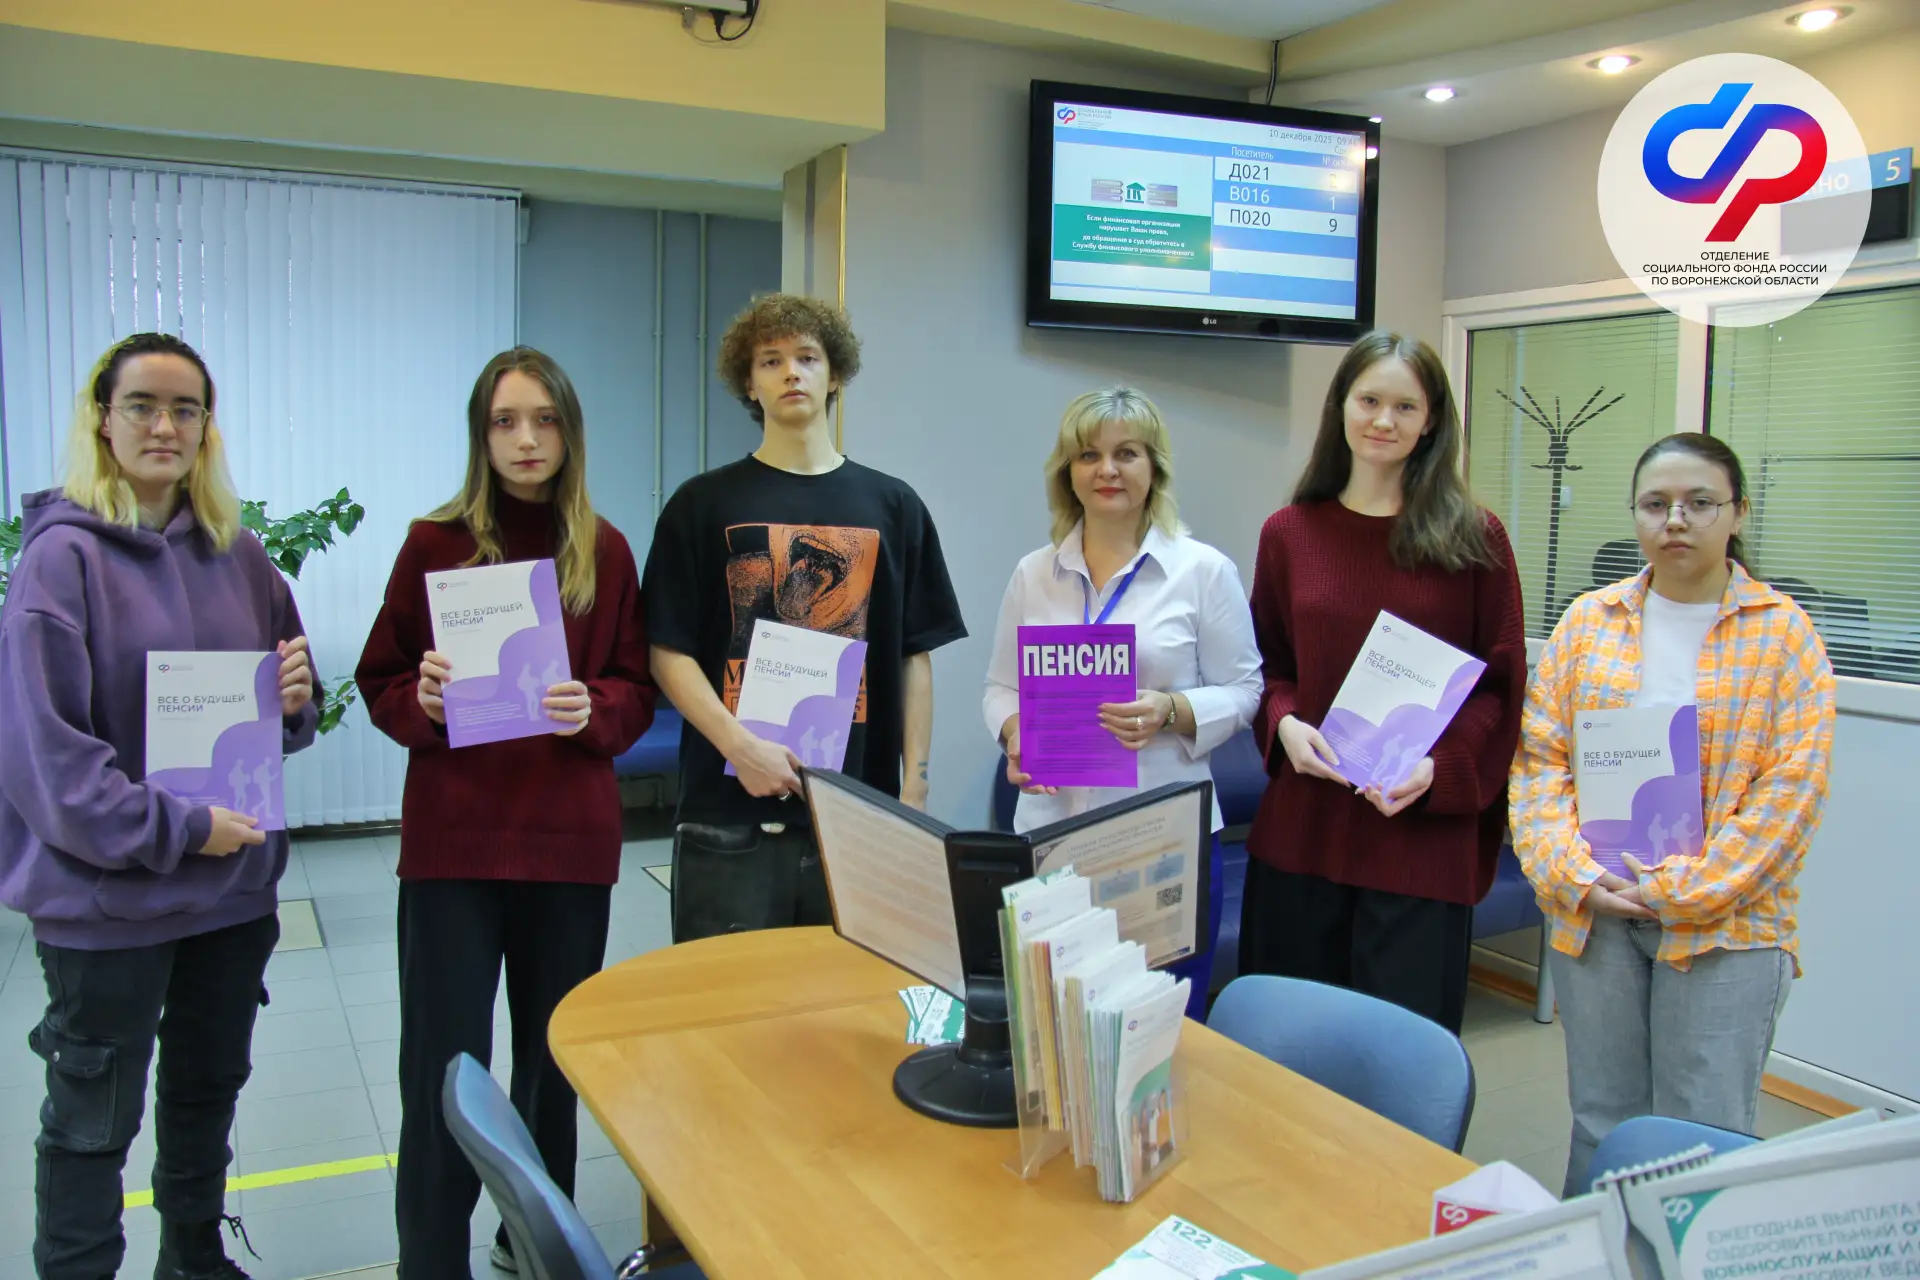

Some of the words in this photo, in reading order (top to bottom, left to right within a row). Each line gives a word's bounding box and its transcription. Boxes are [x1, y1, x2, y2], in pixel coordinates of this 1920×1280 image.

[1269, 129, 1279, 138] 10
[1280, 132, 1312, 143] декабря
[1314, 134, 1332, 144] 2025
[1231, 146, 1274, 160] Посетитель
[1228, 163, 1269, 182] Д021
[1885, 157, 1901, 182] 5
[1230, 185, 1270, 204] В016
[1330, 196, 1336, 210] 1
[1086, 214, 1102, 222] Если
[1230, 208, 1271, 227] П020
[1328, 218, 1338, 232] 9
[1072, 242, 1096, 250] Службу
[1097, 243, 1139, 253] финансового
[440, 610, 460, 620] ВСЕ
[463, 609, 472, 618] О
[474, 602, 523, 616] БУДУЩЕЙ
[442, 616, 484, 629] ПЕНСИИ
[756, 657, 773, 668] ВСЕ
[775, 661, 782, 669] О
[784, 663, 828, 678] БУДУЩЕЙ
[1023, 644, 1130, 676] ПЕНСИЯ
[1364, 656, 1400, 680] ПЕНСИИ
[754, 664, 792, 678] ПЕНСИИ
[1368, 649, 1386, 664] ВСЕ
[1386, 659, 1394, 668] О
[1394, 664, 1436, 690] БУДУЩЕЙ
[157, 696, 179, 704] ВСЕ
[182, 696, 191, 704] О
[194, 693, 246, 705] БУДУЩЕЙ
[157, 704, 204, 713] ПЕНСИИ
[1583, 751, 1601, 760] ВСЕ
[1603, 751, 1612, 760] О
[1613, 748, 1661, 760] БУДУЩЕЙ
[1584, 760, 1622, 768] ПЕНСИИ
[1821, 1201, 1913, 1228] ВЫПЛАТА
[1171, 1220, 1213, 1250] 122
[1702, 1243, 1895, 1280] ВОЕННОСЛУЖАЩИХ
[1898, 1240, 1913, 1256] И
